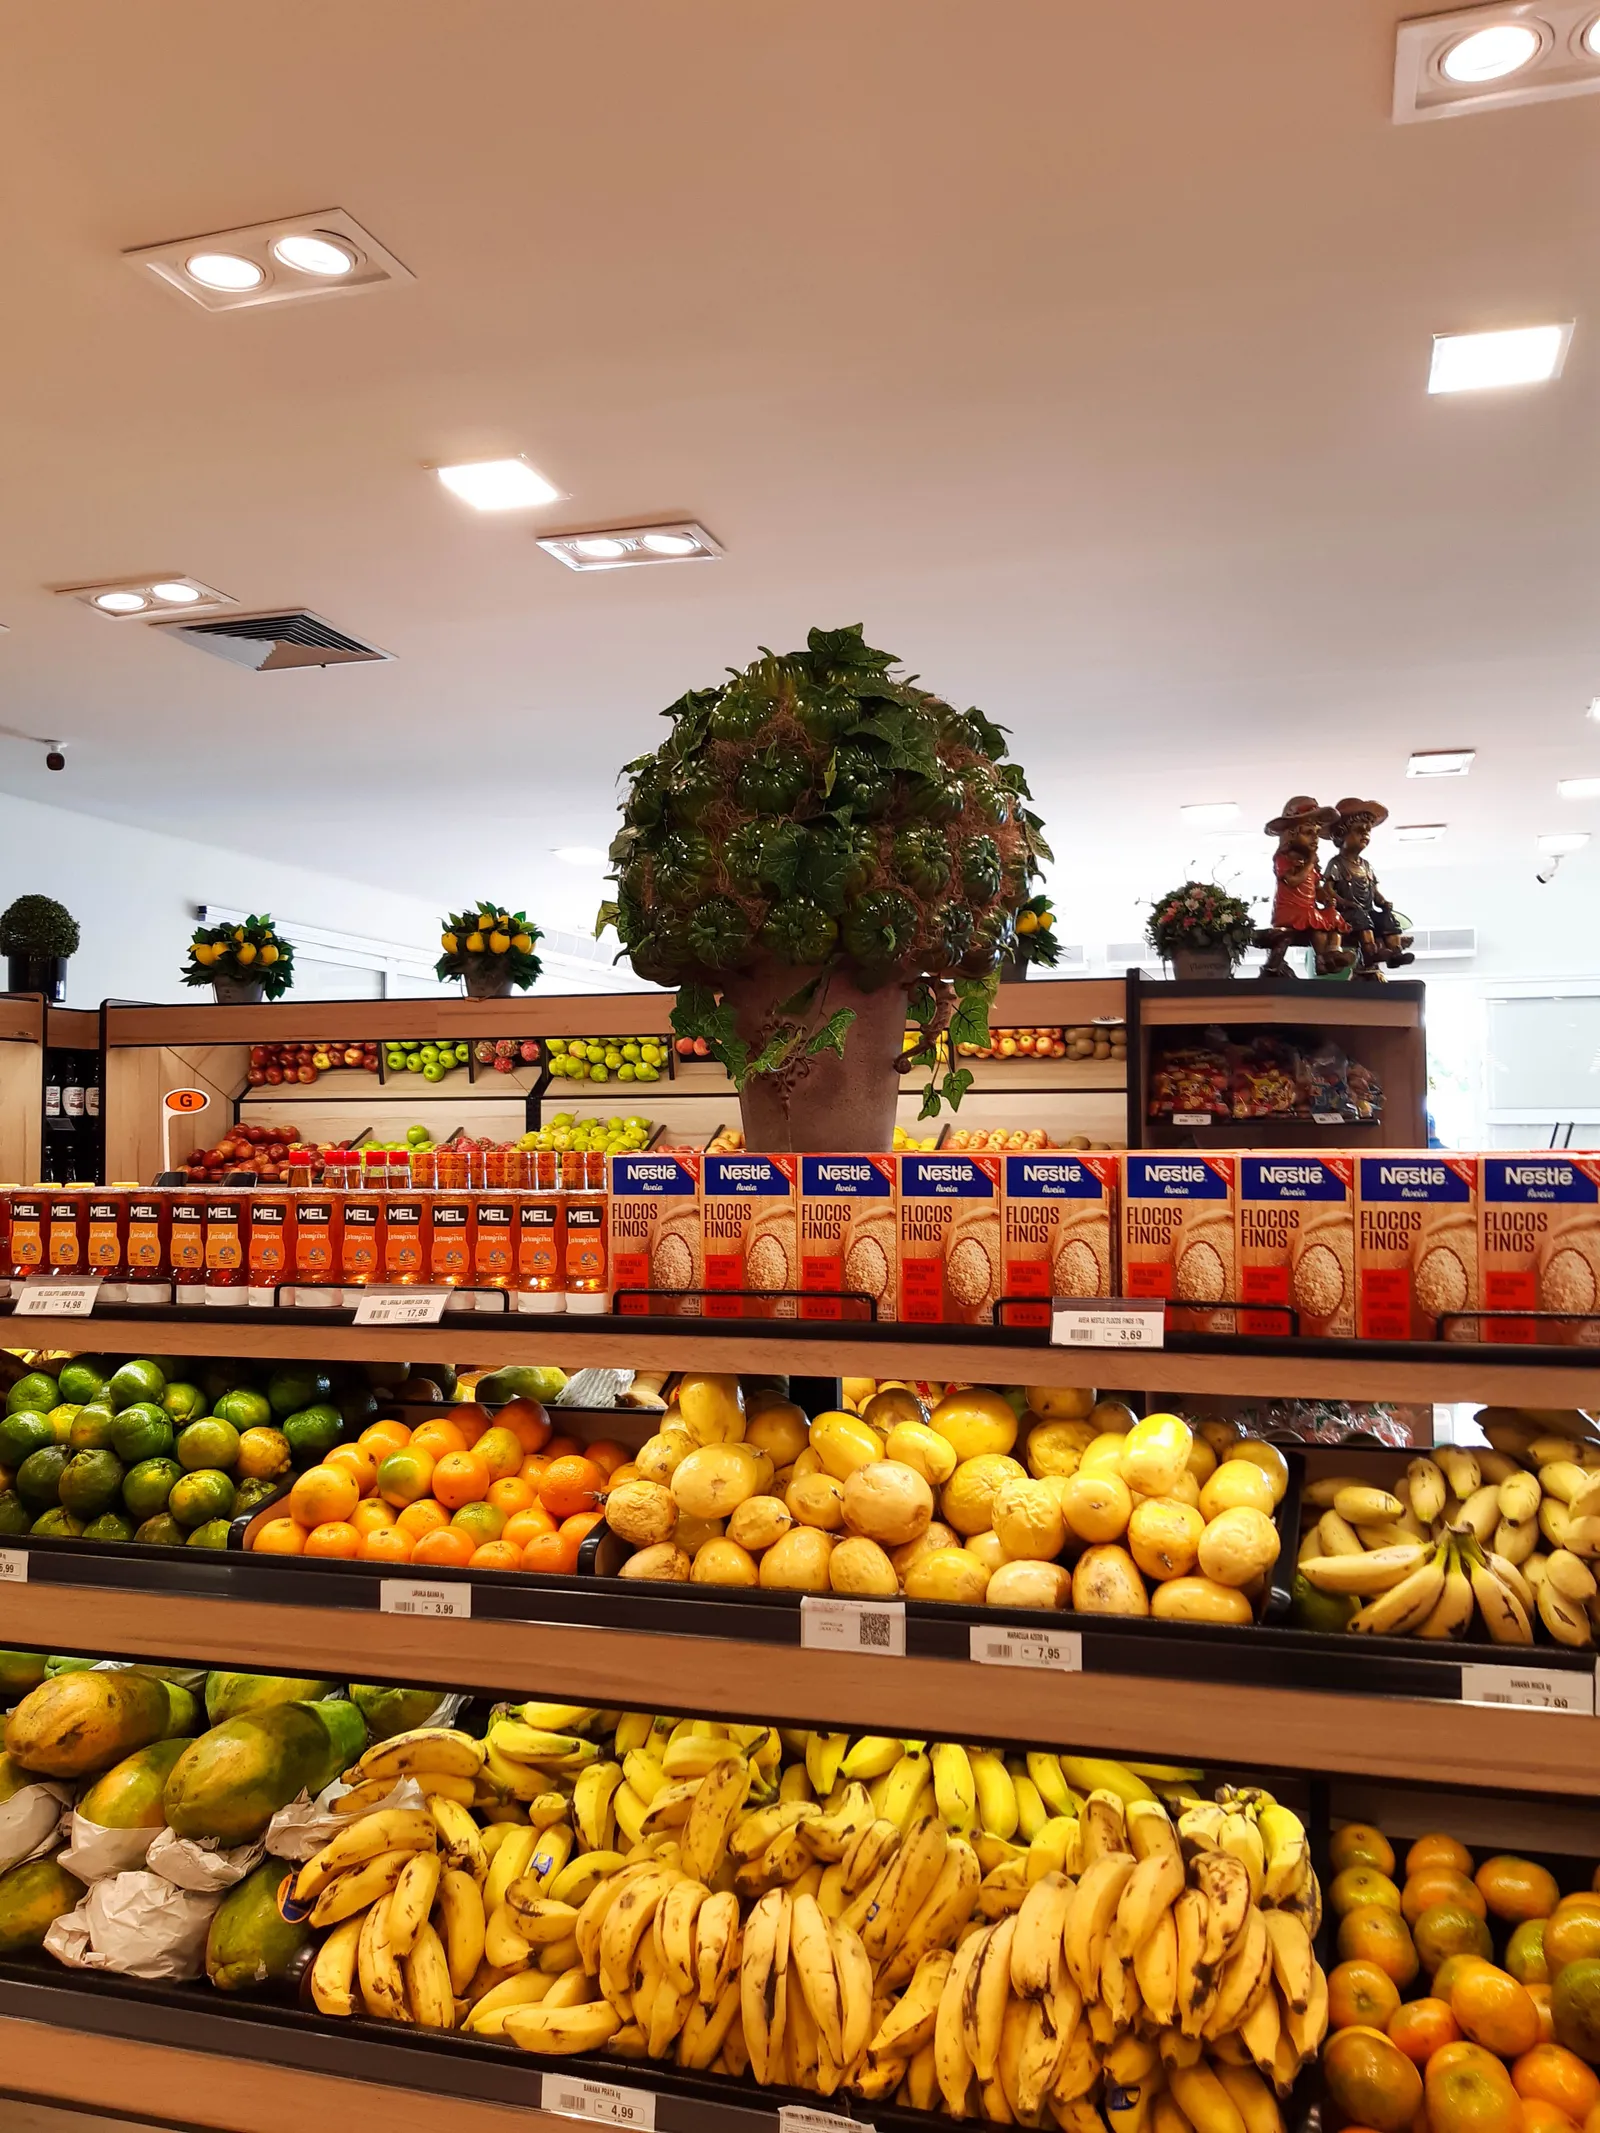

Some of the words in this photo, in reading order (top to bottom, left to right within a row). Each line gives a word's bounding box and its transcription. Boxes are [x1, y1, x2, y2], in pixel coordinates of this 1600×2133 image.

[179, 1093, 193, 1108] G
[643, 1183, 664, 1191] Aveia
[736, 1183, 758, 1192] Aveia
[835, 1183, 857, 1192] Aveia
[935, 1184, 958, 1193] Aveia
[1042, 1184, 1066, 1194] Aveia
[1164, 1185, 1190, 1195] Aveia
[13, 1205, 39, 1217] MEL
[51, 1205, 76, 1217] MEL
[90, 1206, 116, 1217] MEL
[130, 1206, 157, 1218] MEL
[172, 1207, 200, 1219] MEL
[208, 1207, 237, 1219] MEL
[253, 1208, 282, 1220] MEL
[299, 1208, 328, 1220] MEL
[345, 1209, 375, 1221] MEL
[388, 1208, 418, 1220] MEL
[434, 1210, 465, 1222] MEL
[478, 1209, 509, 1221] MEL
[522, 1210, 553, 1222] MEL
[568, 1211, 599, 1223] MEL
[612, 1203, 658, 1220] FLOCOS
[704, 1203, 752, 1220] FLOCOS
[802, 1203, 851, 1221] FLOCOS
[901, 1204, 953, 1223] FLOCOS
[1006, 1206, 1060, 1225] FLOCOS
[1126, 1206, 1183, 1226] FLOCOS
[1241, 1209, 1300, 1229] FLOCOS
[1361, 1210, 1422, 1231] FLOCOS
[1484, 1211, 1548, 1232] FLOCOS
[612, 1220, 648, 1237] FINOS
[704, 1221, 742, 1238] FINOS
[802, 1222, 841, 1239] FINOS
[901, 1223, 942, 1241] FINOS
[1006, 1225, 1049, 1243] FINOS
[1127, 1226, 1171, 1245] FINOS
[1241, 1228, 1287, 1248] FINOS
[1361, 1231, 1409, 1251] FINOS
[1484, 1232, 1535, 1252] FINOS
[62, 1301, 81, 1309] 14,98
[407, 1309, 428, 1317] 17,98
[1120, 1330, 1142, 1340] 3,69
[1038, 1646, 1060, 1660] 7,95
[583, 2084, 601, 2094] BANANA
[601, 2088, 615, 2097] PRATA
[611, 2105, 634, 2119] 4,99
